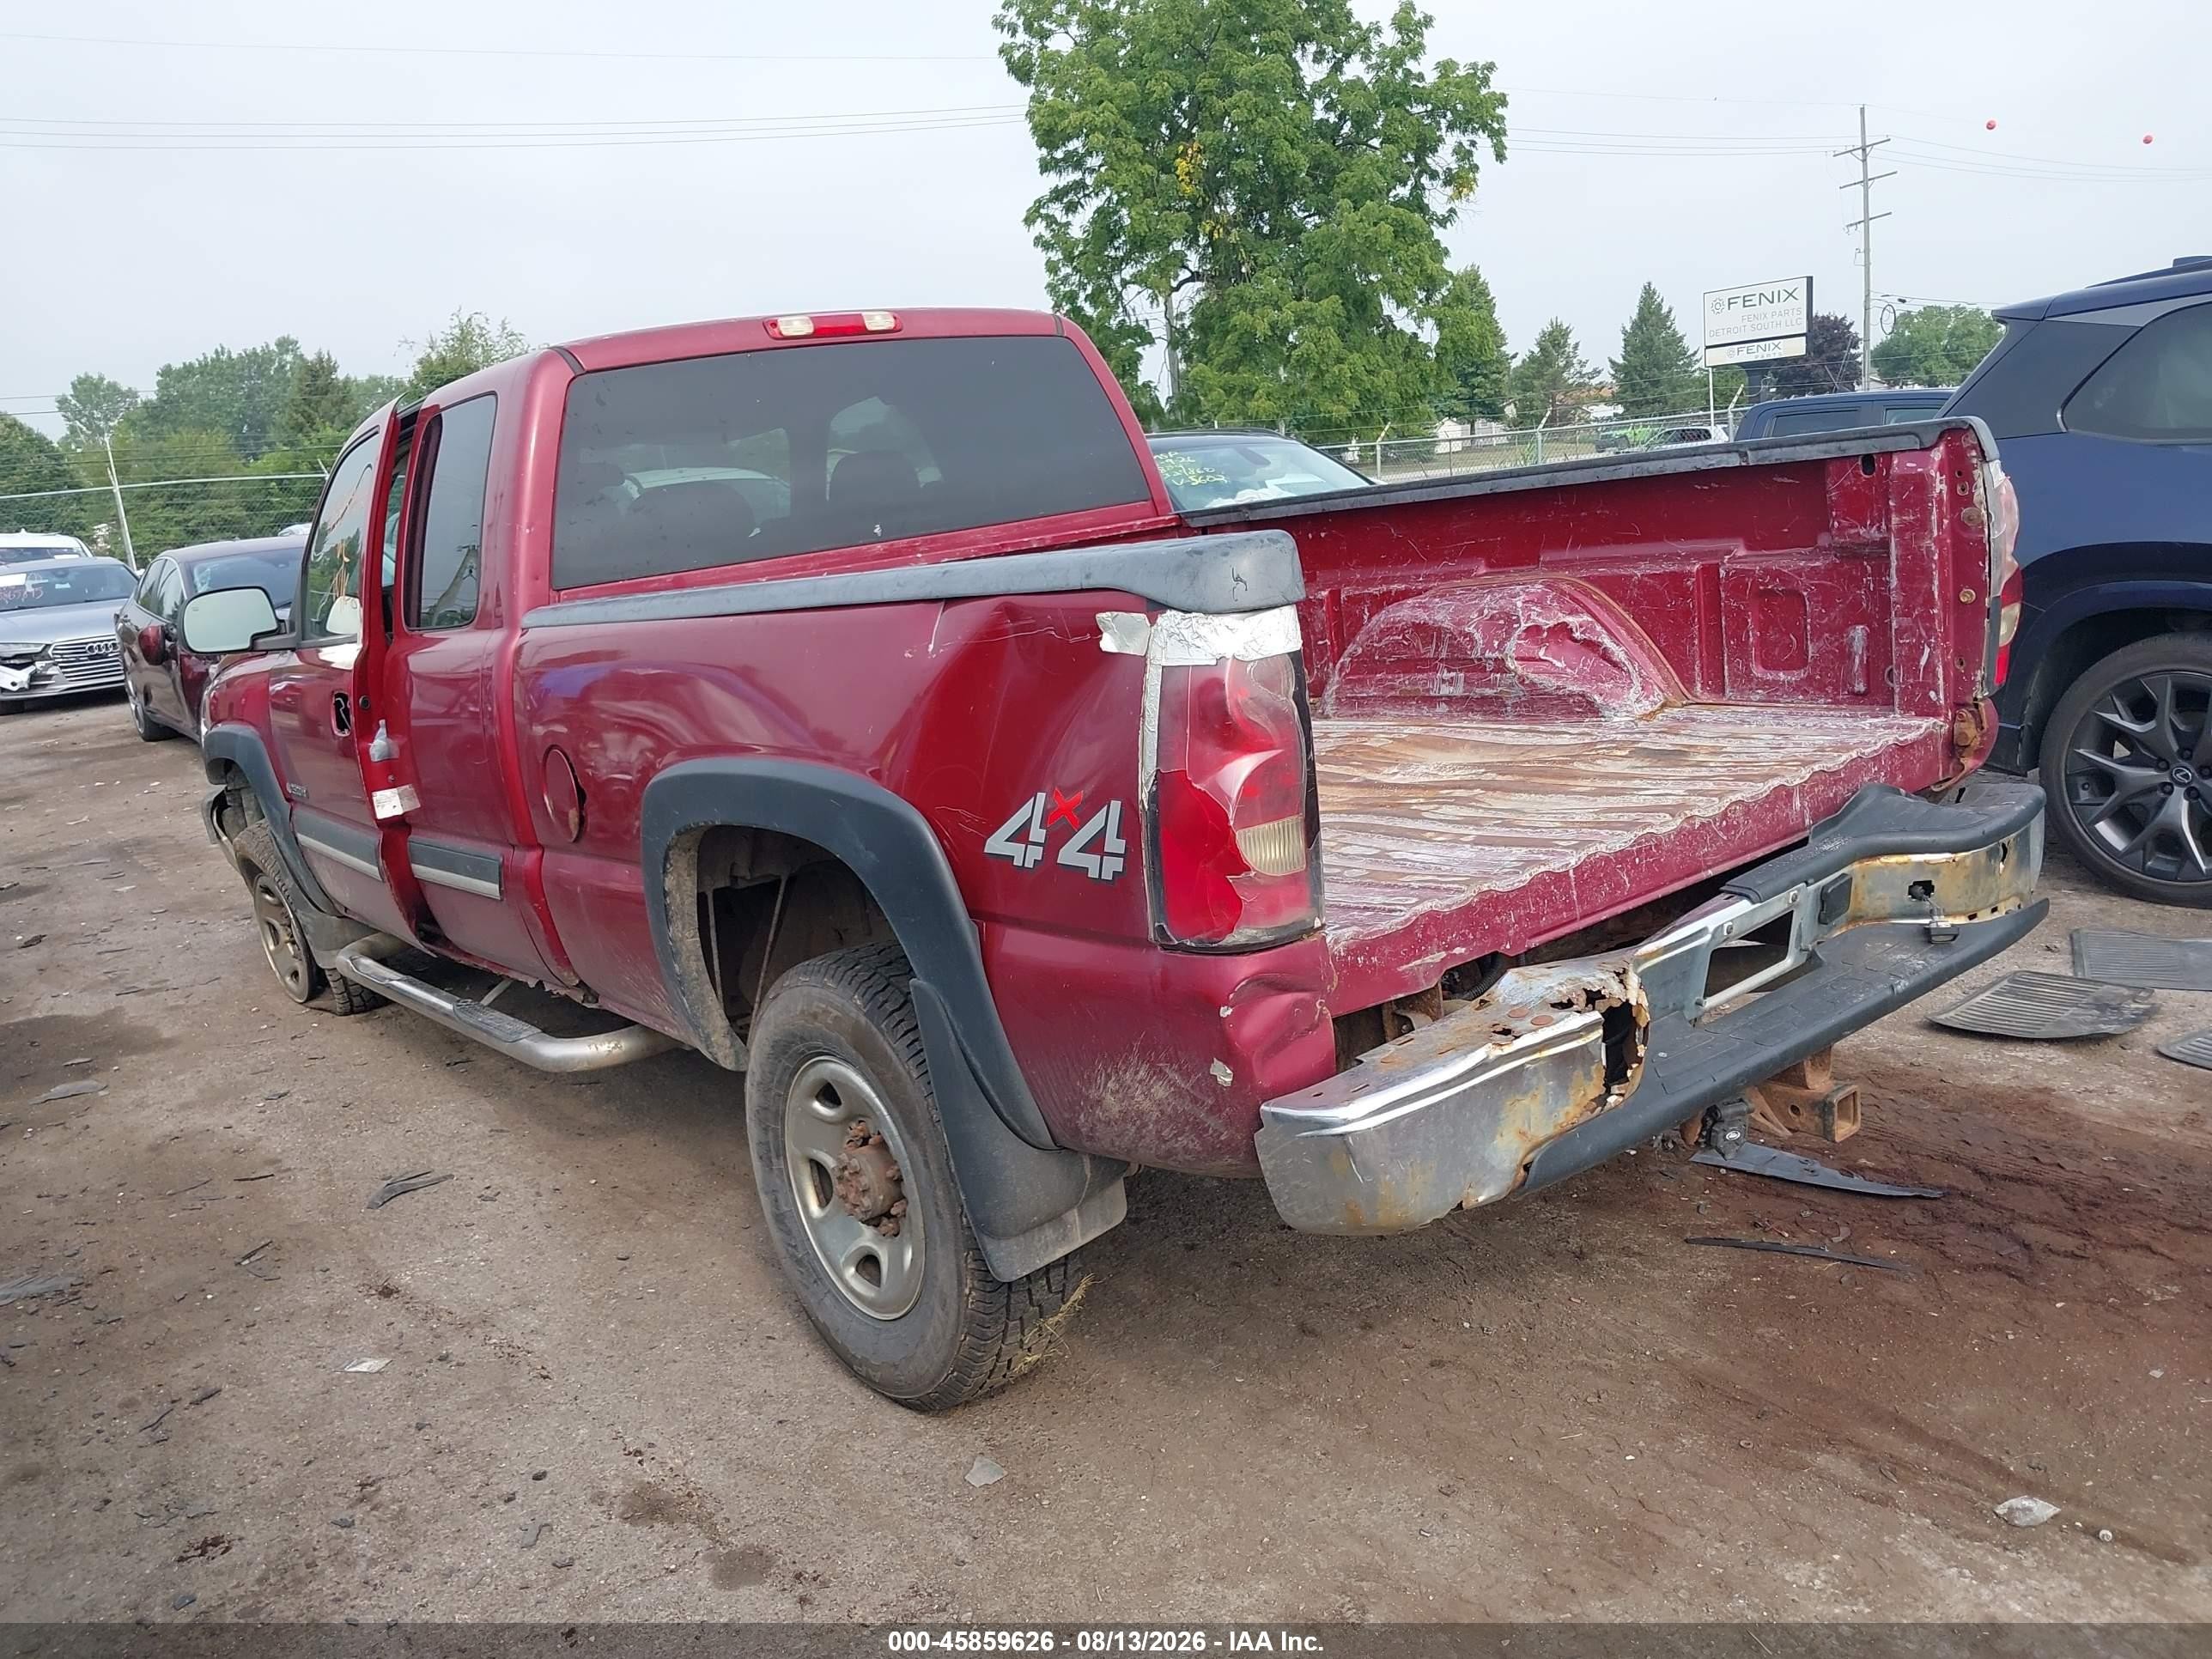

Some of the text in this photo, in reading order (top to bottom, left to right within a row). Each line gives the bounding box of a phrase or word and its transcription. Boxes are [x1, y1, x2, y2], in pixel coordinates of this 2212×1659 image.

[1728, 287, 1799, 310] FENIX
[1741, 307, 1802, 323] FENIX PARTS
[1709, 317, 1802, 337] DETROIT SOUTH LLC
[1736, 342, 1782, 356] FENIX
